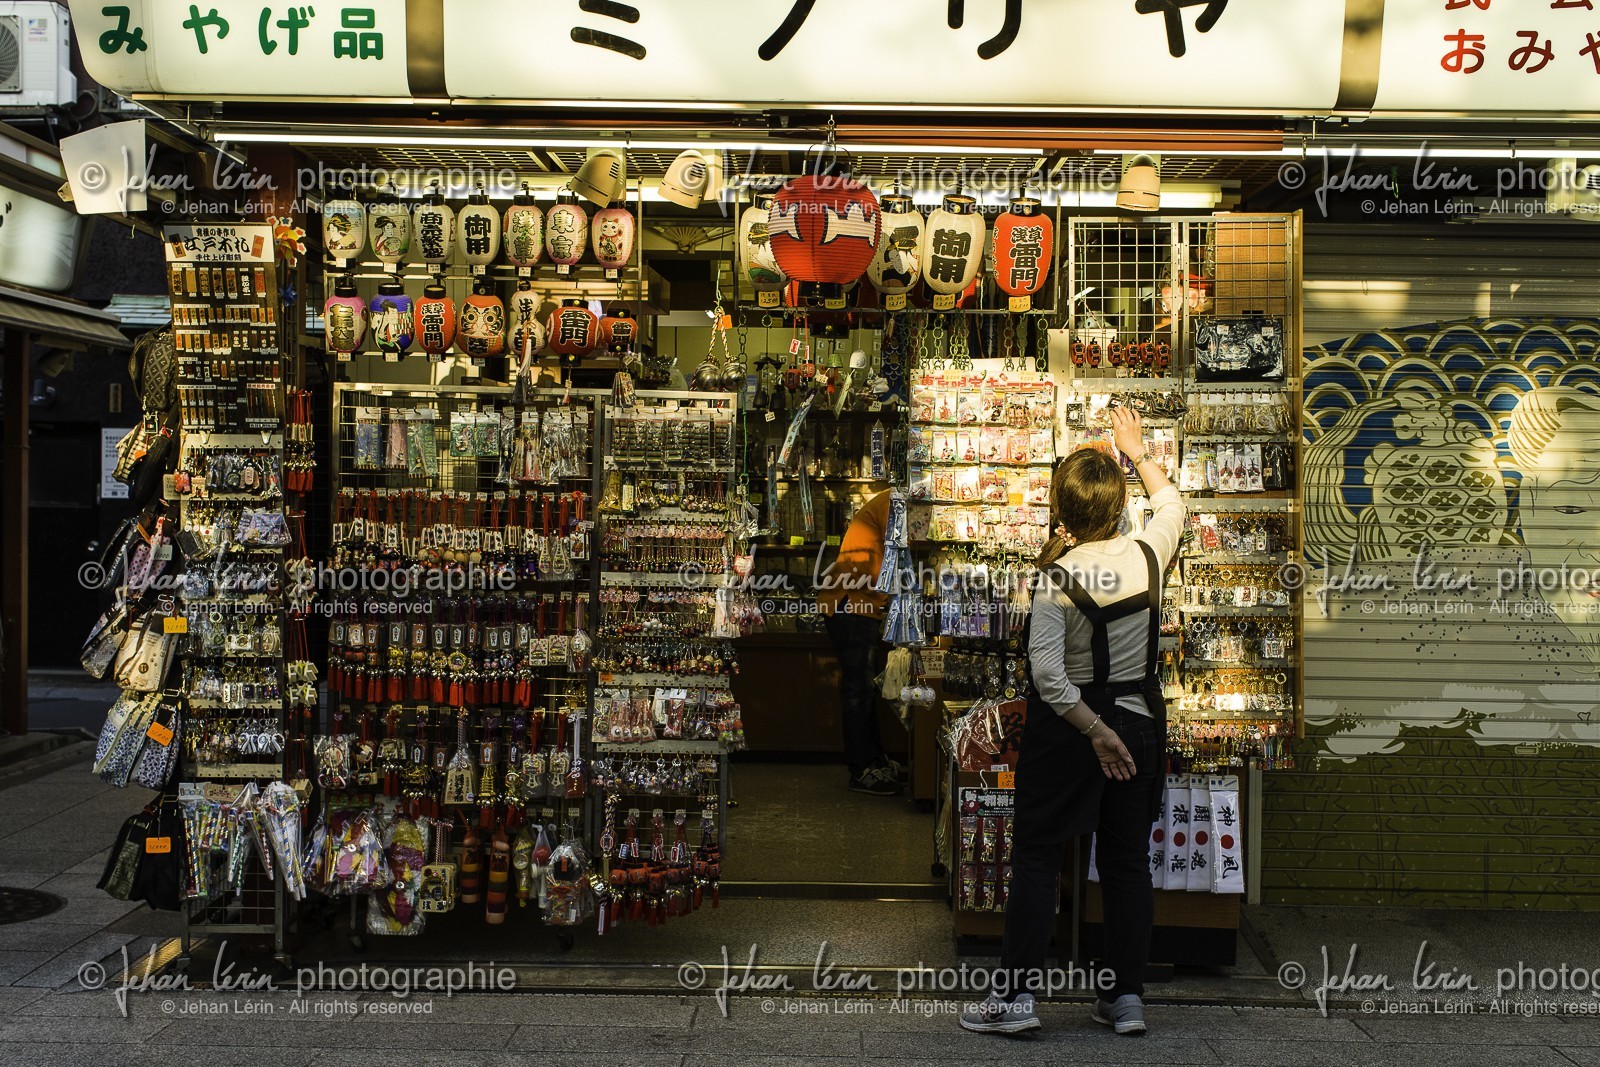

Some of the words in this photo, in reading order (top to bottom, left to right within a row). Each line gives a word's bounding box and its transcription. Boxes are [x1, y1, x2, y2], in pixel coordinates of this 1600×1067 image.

[99, 5, 383, 60] みやげ品
[464, 214, 491, 254] 御用
[552, 209, 575, 259] 東京
[929, 228, 971, 283] 御用
[1009, 243, 1042, 291] 雷門
[421, 315, 445, 349] 雷門
[558, 310, 590, 347] 雷門
[1171, 804, 1189, 873] 根性
[1217, 805, 1239, 879] 神風
